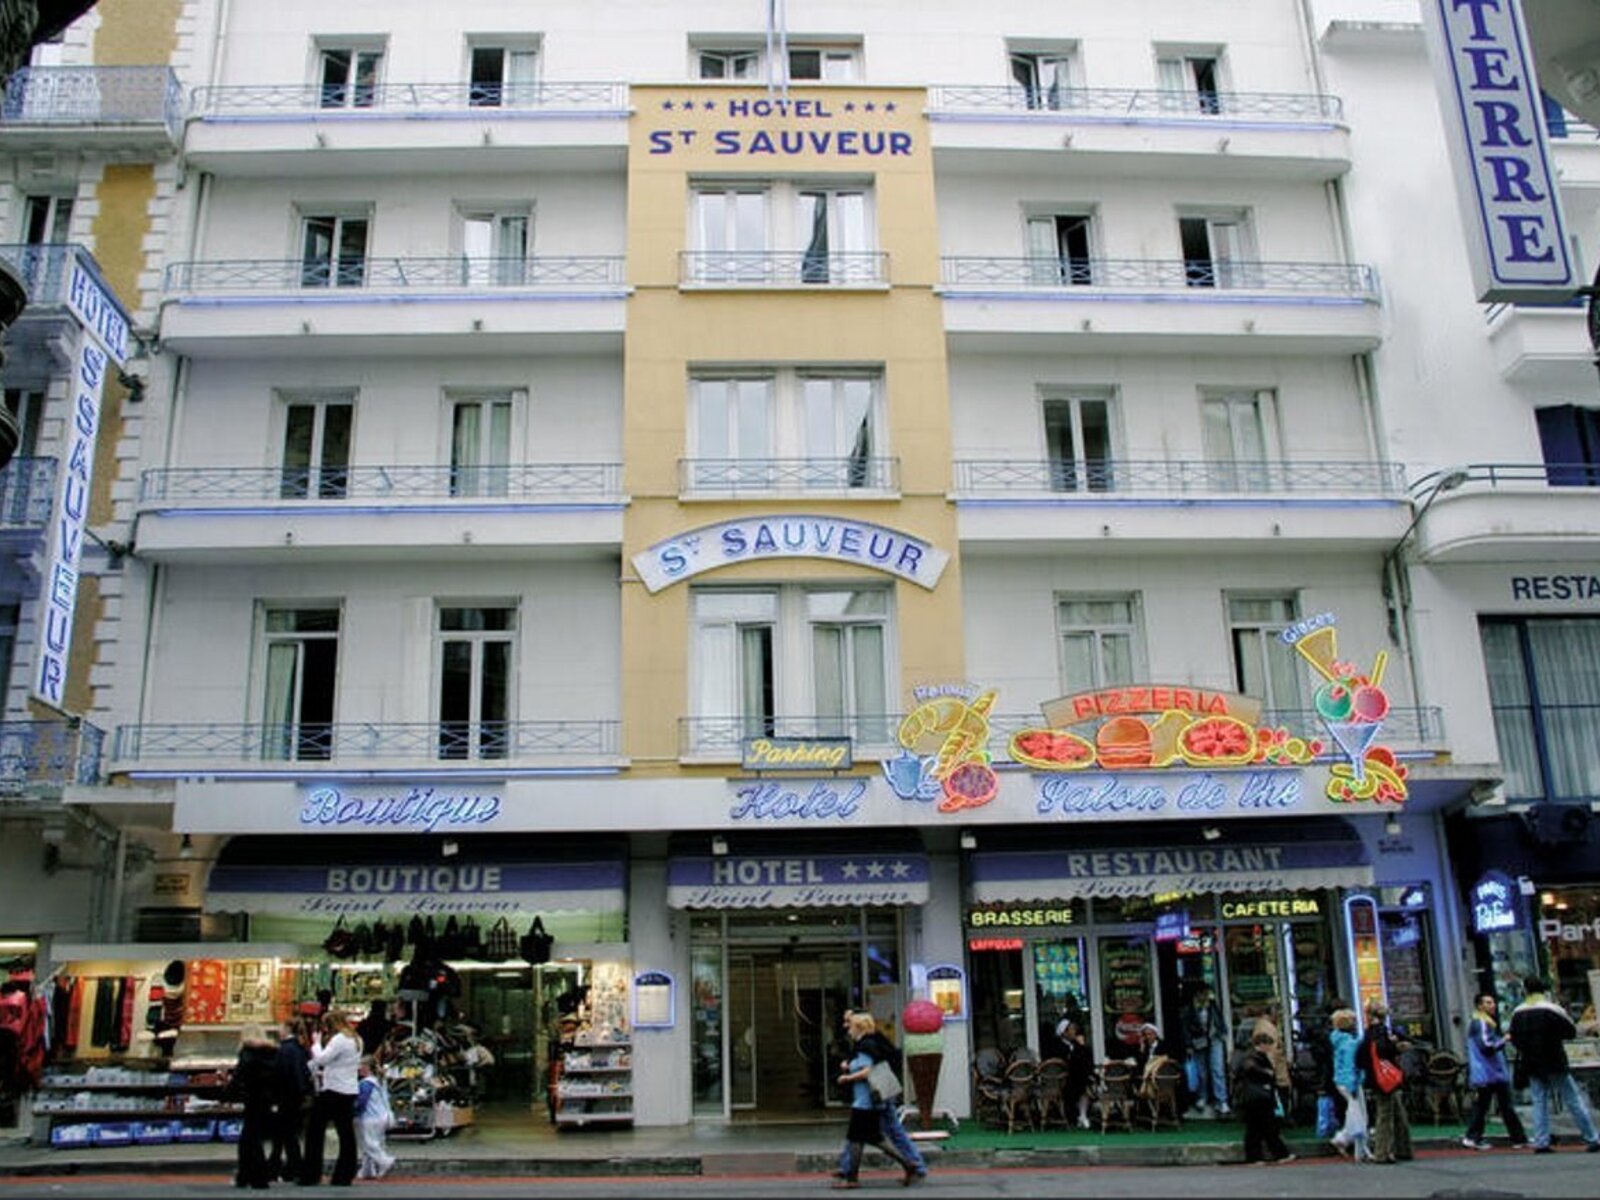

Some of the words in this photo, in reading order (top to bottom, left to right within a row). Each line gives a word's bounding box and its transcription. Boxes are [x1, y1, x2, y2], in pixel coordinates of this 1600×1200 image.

[728, 100, 832, 117] HOTEL
[715, 131, 912, 155] SAUVEUR
[71, 267, 126, 361] HOTEL
[40, 394, 95, 701] SAUVEUR
[722, 523, 923, 575] SAUVEUR
[1073, 686, 1228, 717] PIZZERIA
[748, 739, 847, 767] Parking
[731, 780, 866, 819] Hotel
[1037, 775, 1166, 814] Salon
[1177, 773, 1226, 810] de
[299, 786, 501, 833] Boutique
[712, 860, 823, 884] HOTEL
[1067, 848, 1282, 877] RESTAURANT
[326, 866, 501, 893] BOUTIQUE
[300, 897, 383, 912] Saint
[405, 896, 520, 912] Sauveur
[688, 888, 772, 905] Saint
[794, 884, 908, 902] Sauveur
[971, 909, 1074, 926] BRASSERIE
[1222, 900, 1319, 918] CAFETERIA
